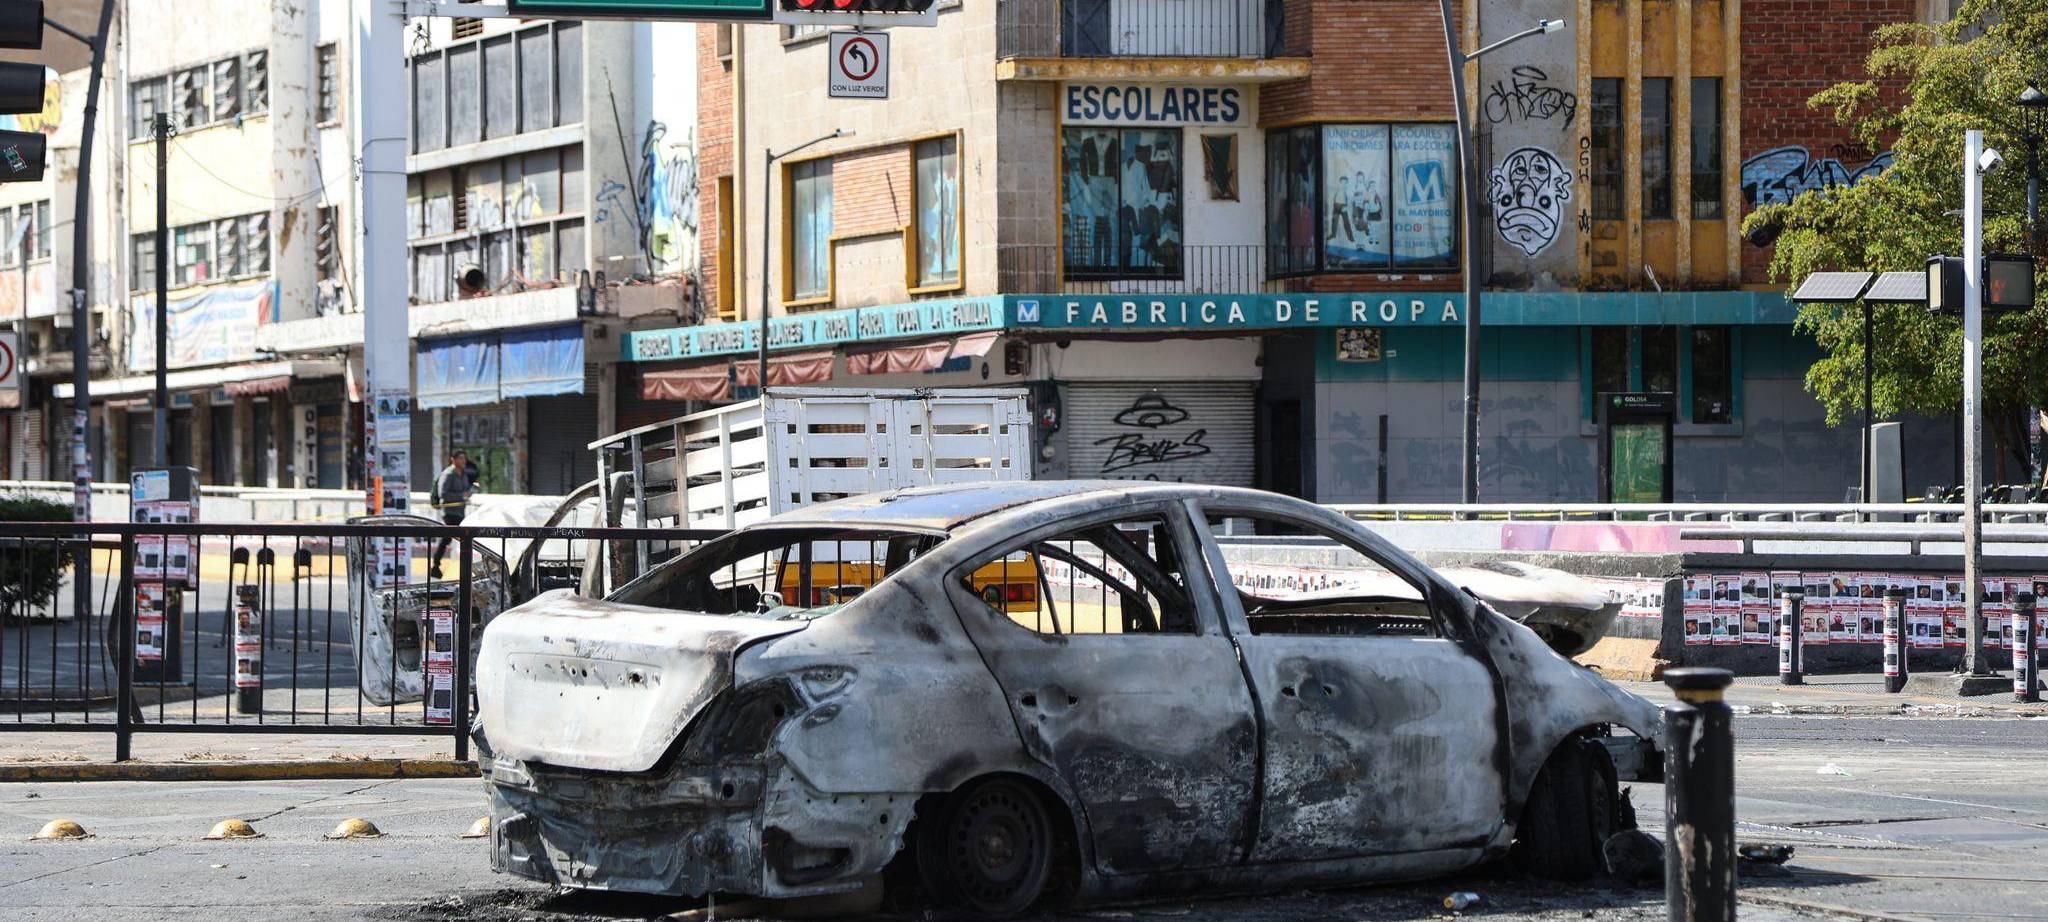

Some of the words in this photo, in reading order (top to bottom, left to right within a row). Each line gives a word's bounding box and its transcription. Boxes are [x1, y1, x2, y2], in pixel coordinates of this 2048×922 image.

[862, 85, 885, 93] VERDE
[1067, 86, 1240, 123] ESCOLARES
[1328, 128, 1386, 138] UNIFORMES
[1393, 128, 1438, 138] SCOLARES
[1328, 142, 1384, 151] UNIFORMES
[1398, 208, 1407, 217] EL
[1409, 208, 1452, 217] MAYOREO
[930, 304, 944, 329] LA
[1066, 301, 1245, 323] FABRICA
[1276, 300, 1320, 322] DE
[1351, 300, 1458, 322] ROPA
